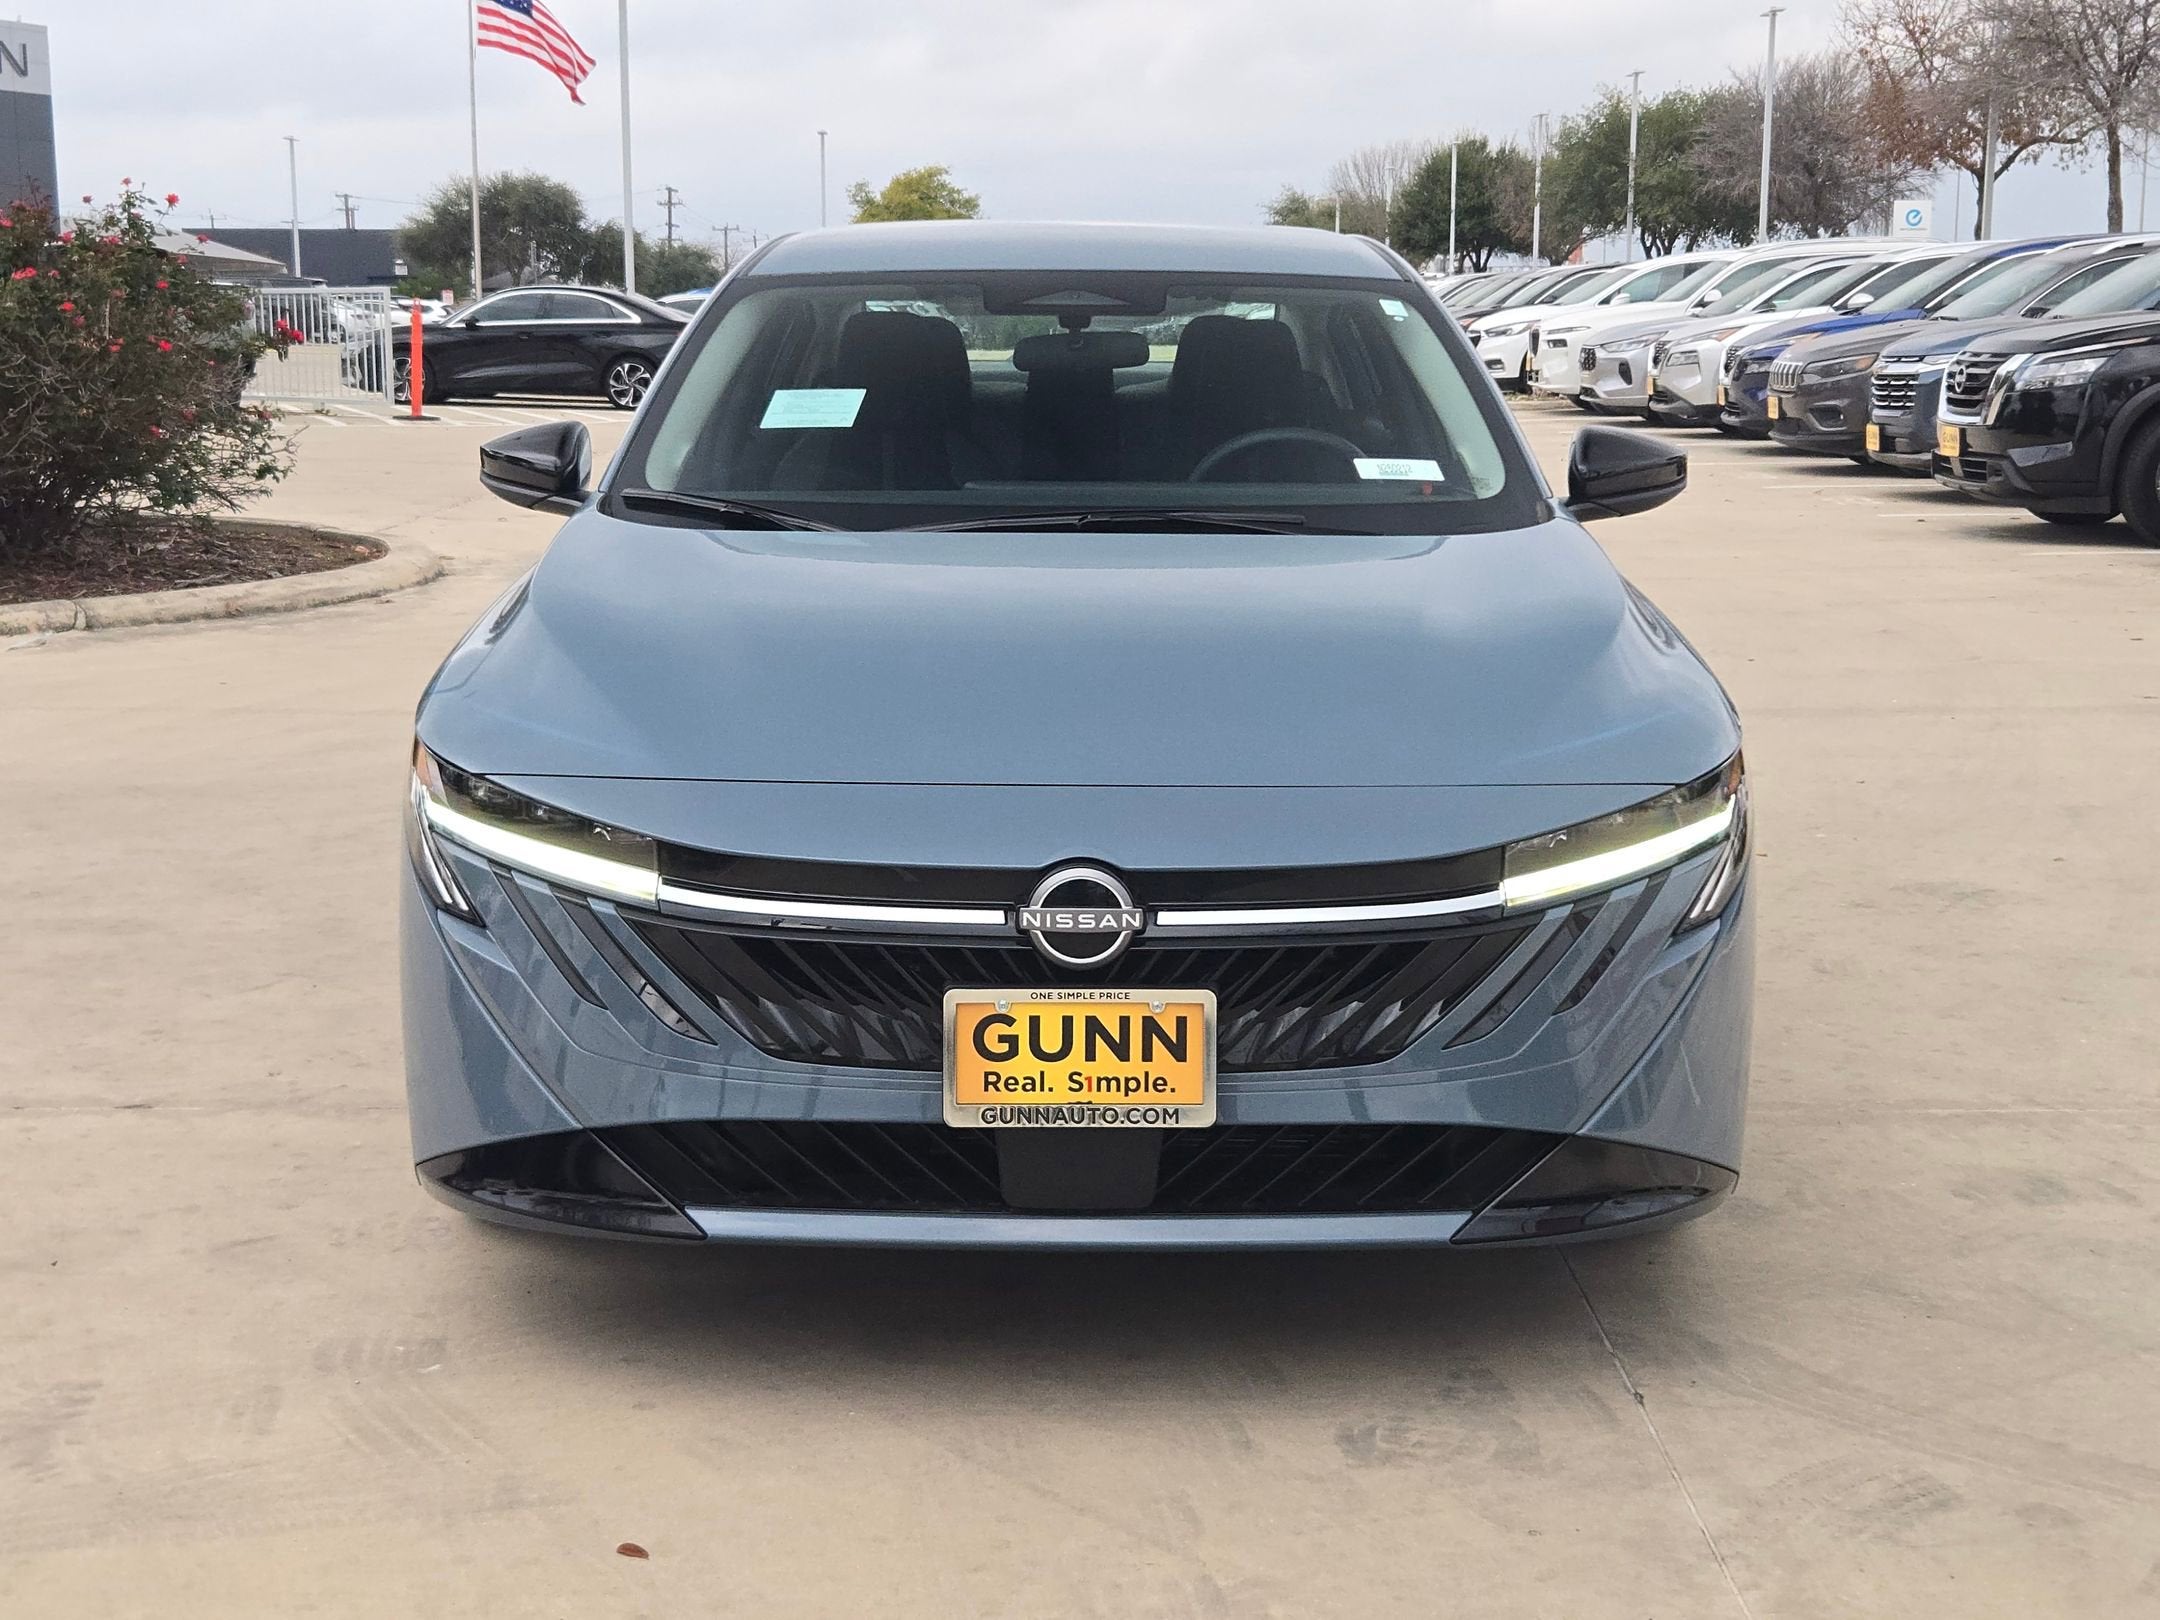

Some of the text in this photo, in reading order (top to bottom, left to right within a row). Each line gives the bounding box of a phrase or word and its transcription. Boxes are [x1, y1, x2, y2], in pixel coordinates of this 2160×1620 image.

[1022, 912, 1140, 929] NISSAN
[1030, 992, 1131, 1000] ONE SIMPLE PRICE
[972, 1013, 1188, 1063] GUNN
[983, 1070, 1054, 1092] Real.
[980, 1107, 1180, 1125] GUNNAUTO.COM
